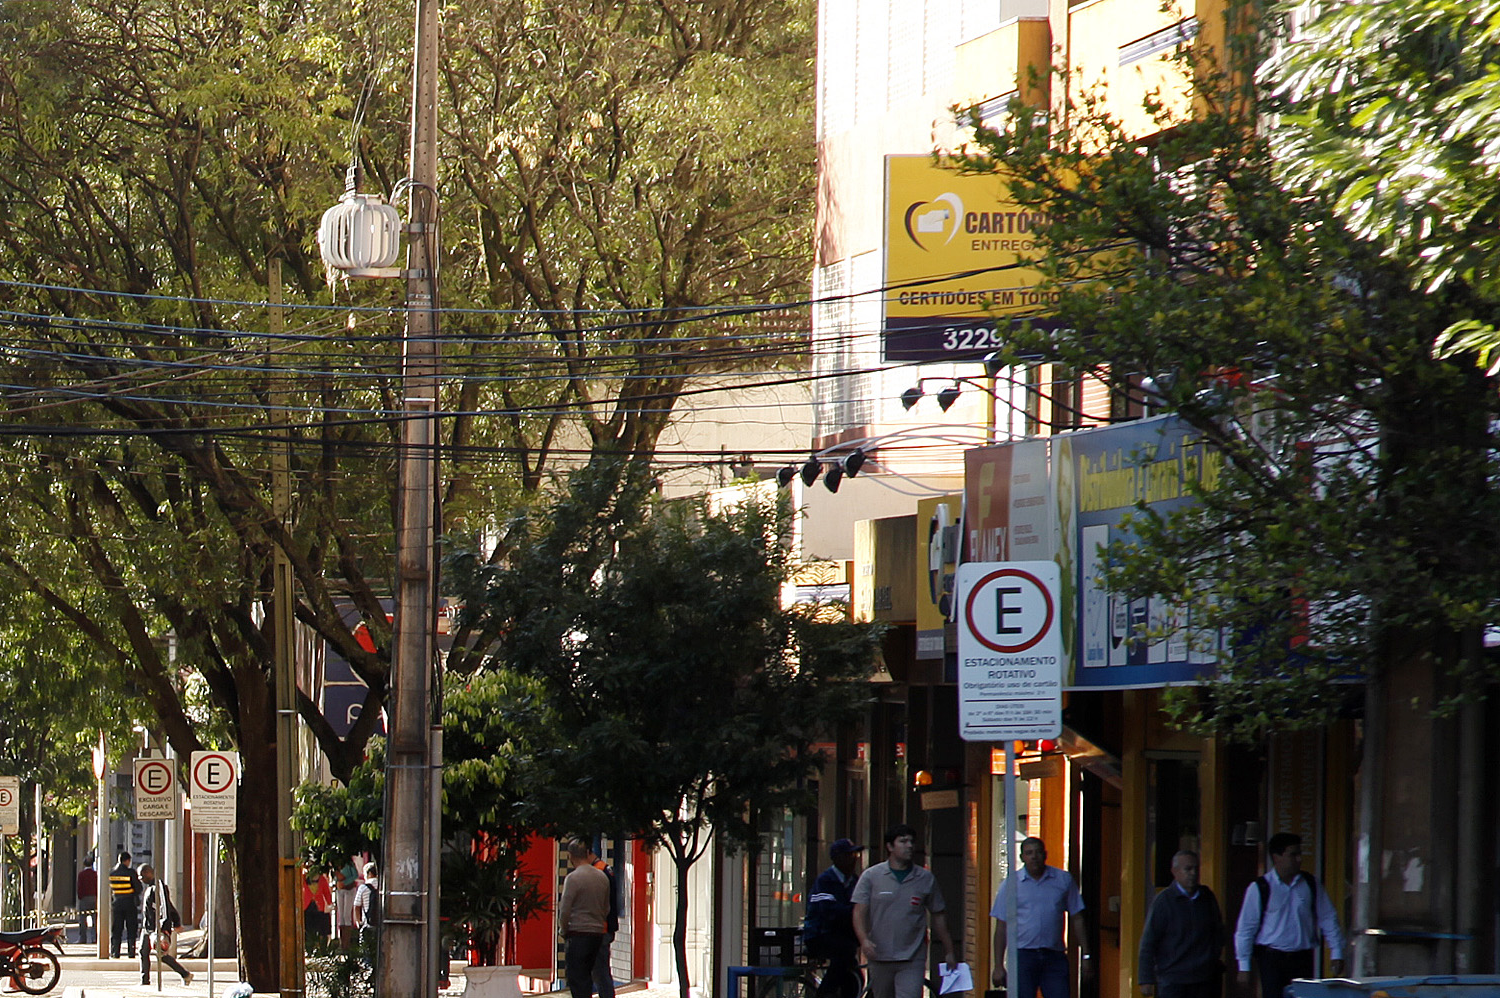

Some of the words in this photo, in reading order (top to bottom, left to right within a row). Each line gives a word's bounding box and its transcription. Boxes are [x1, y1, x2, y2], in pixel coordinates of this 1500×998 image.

[900, 289, 987, 305] CERTIDÕES
[993, 291, 1014, 305] EM
[995, 587, 1022, 634] E
[964, 656, 1056, 667] ESTACIONAMENTO
[988, 670, 1036, 679] ROTATIVO
[148, 769, 162, 788] E
[208, 763, 219, 785] E
[0, 792, 6, 803] E
